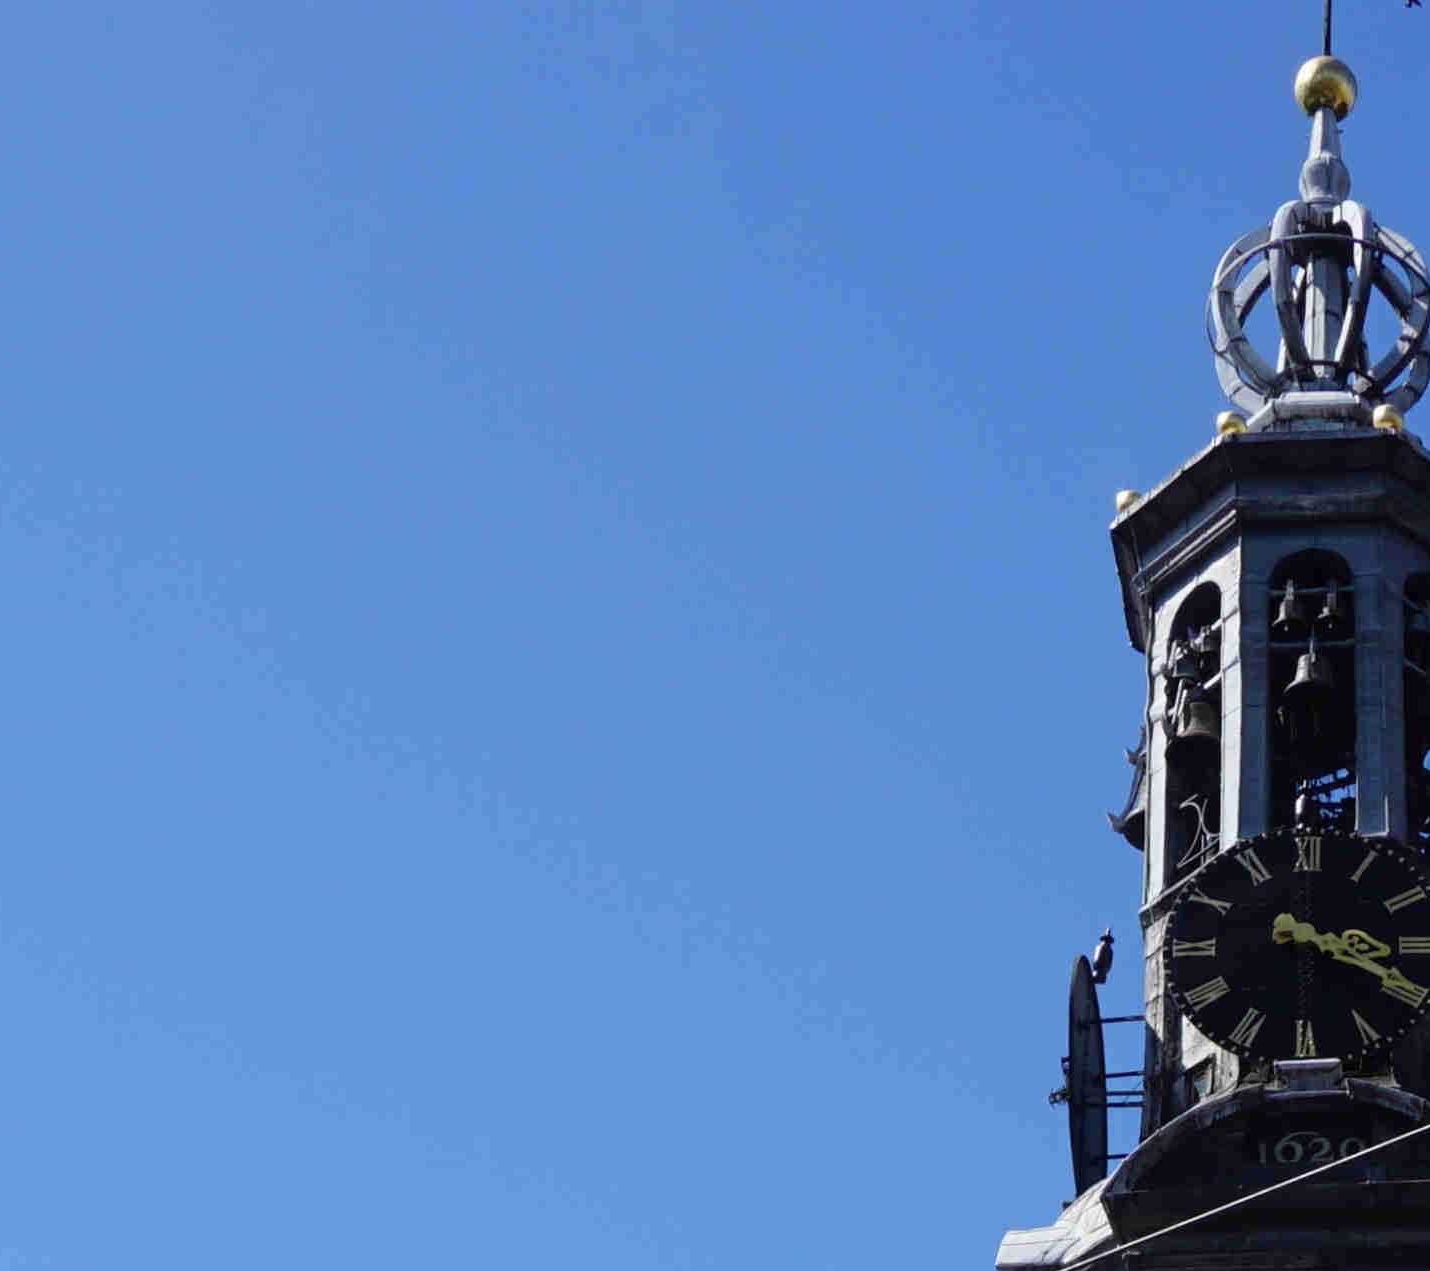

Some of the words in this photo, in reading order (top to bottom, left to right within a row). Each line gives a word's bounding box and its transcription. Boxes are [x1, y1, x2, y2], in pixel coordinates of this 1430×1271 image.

[1292, 835, 1322, 872] XII
[1384, 885, 1427, 914] II
[1173, 937, 1217, 958] IX
[1257, 1131, 1366, 1167] 1620
